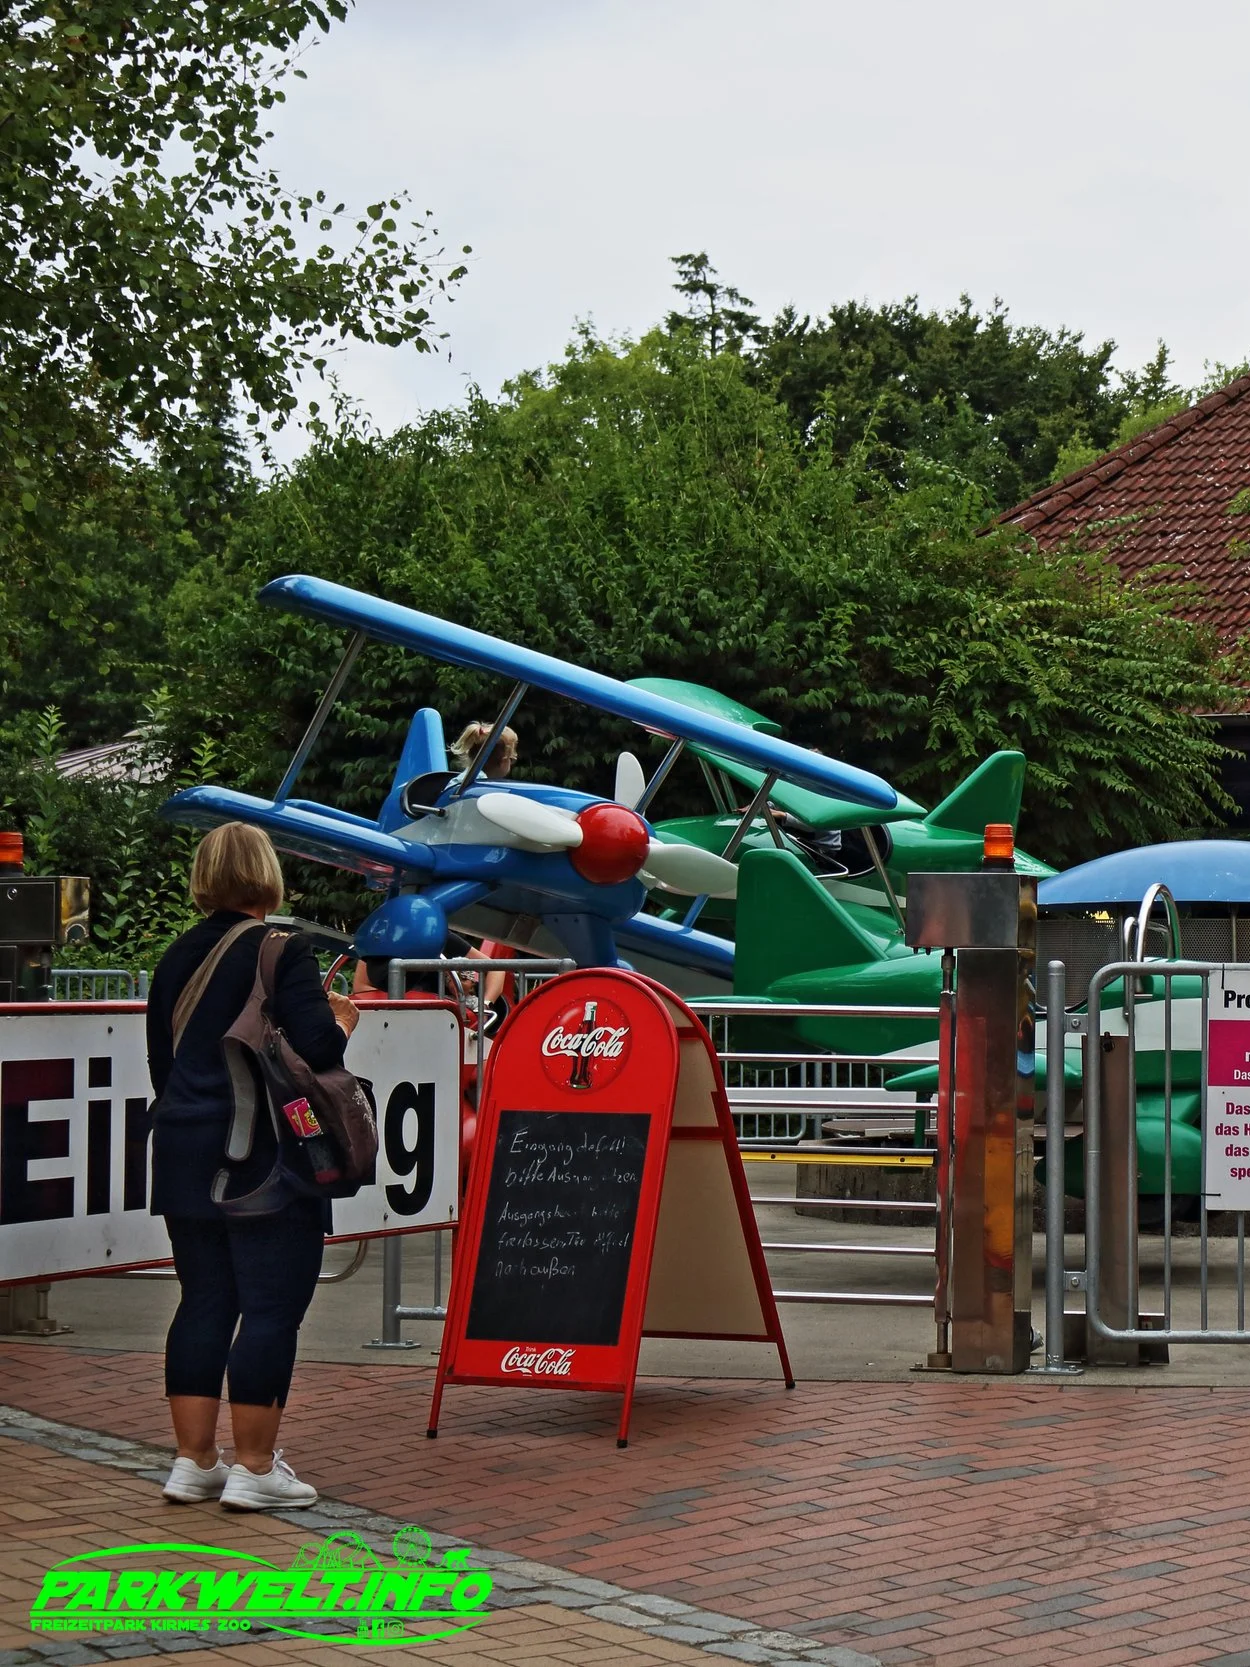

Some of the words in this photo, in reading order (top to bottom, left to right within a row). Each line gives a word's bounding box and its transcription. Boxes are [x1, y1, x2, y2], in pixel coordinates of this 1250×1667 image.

[542, 1026, 629, 1057] Coca-Cola
[1226, 1102, 1250, 1115] Das
[1215, 1123, 1239, 1135] das
[1225, 1144, 1249, 1156] das
[501, 1346, 576, 1376] Coca-Cola
